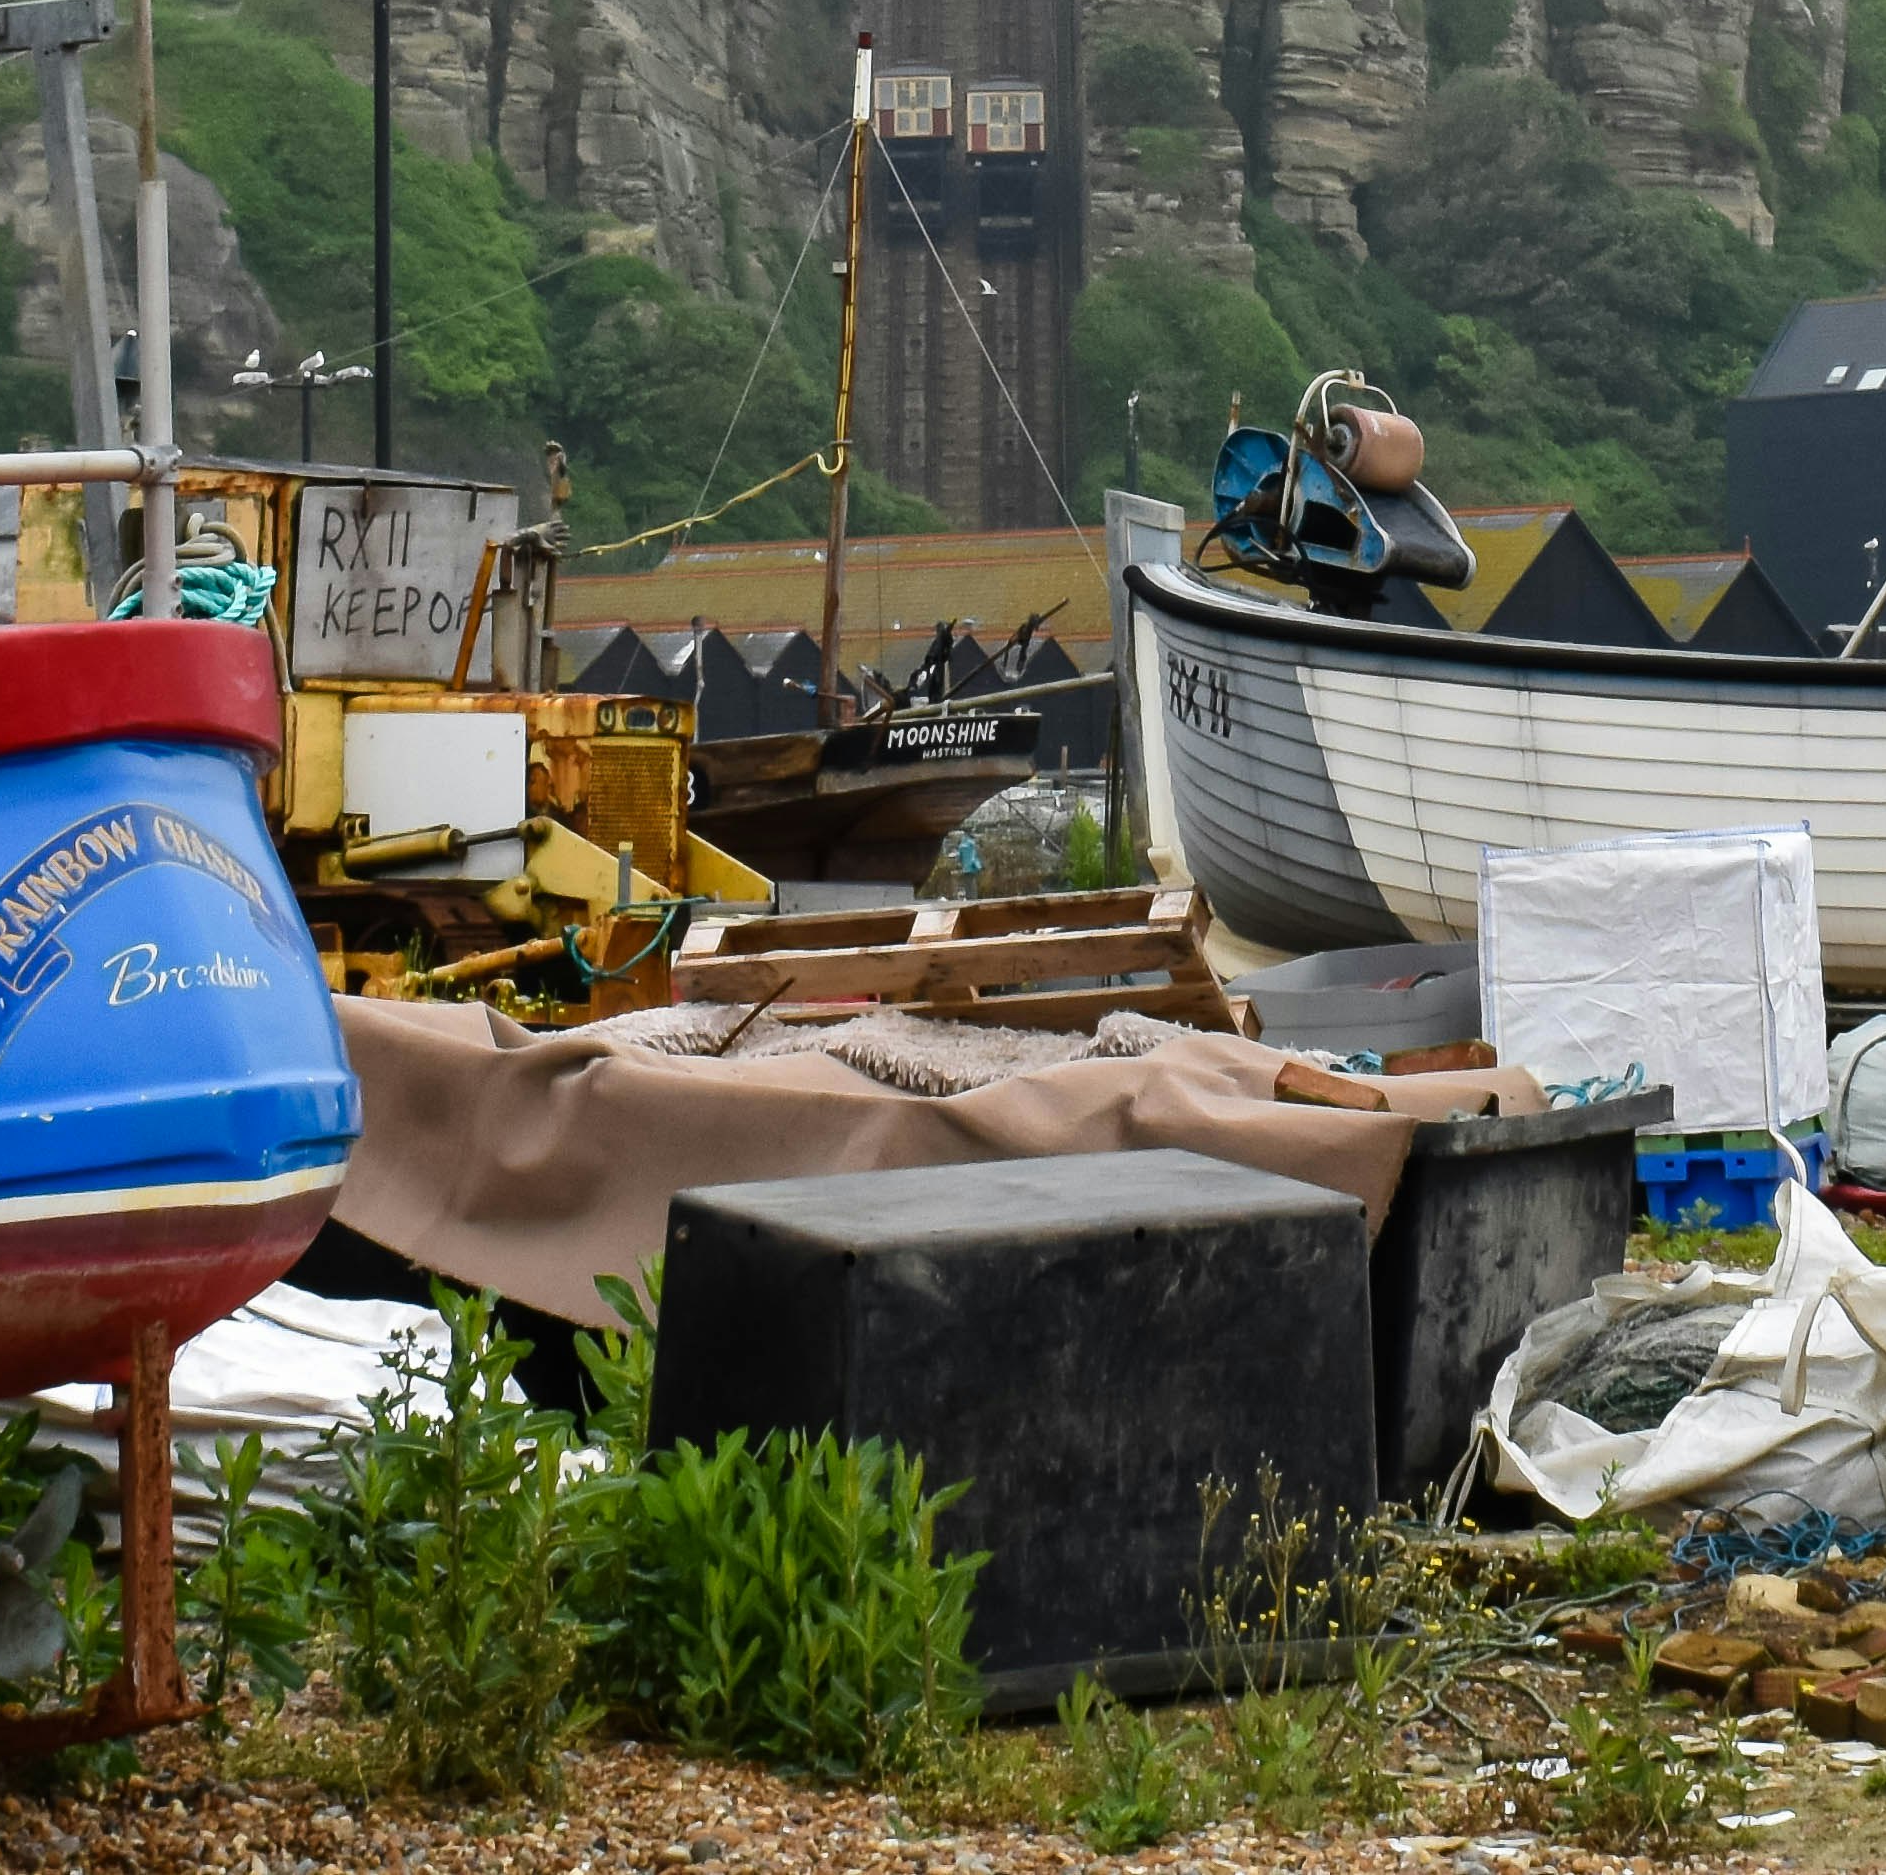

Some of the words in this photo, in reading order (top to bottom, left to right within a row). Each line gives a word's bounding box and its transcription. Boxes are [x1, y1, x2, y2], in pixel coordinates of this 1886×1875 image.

[320, 583, 422, 639] KEEP
[428, 590, 493, 634] OF
[887, 720, 999, 749] MOONSHINE
[922, 746, 973, 760] HASTINGS
[152, 814, 270, 915] CHASER
